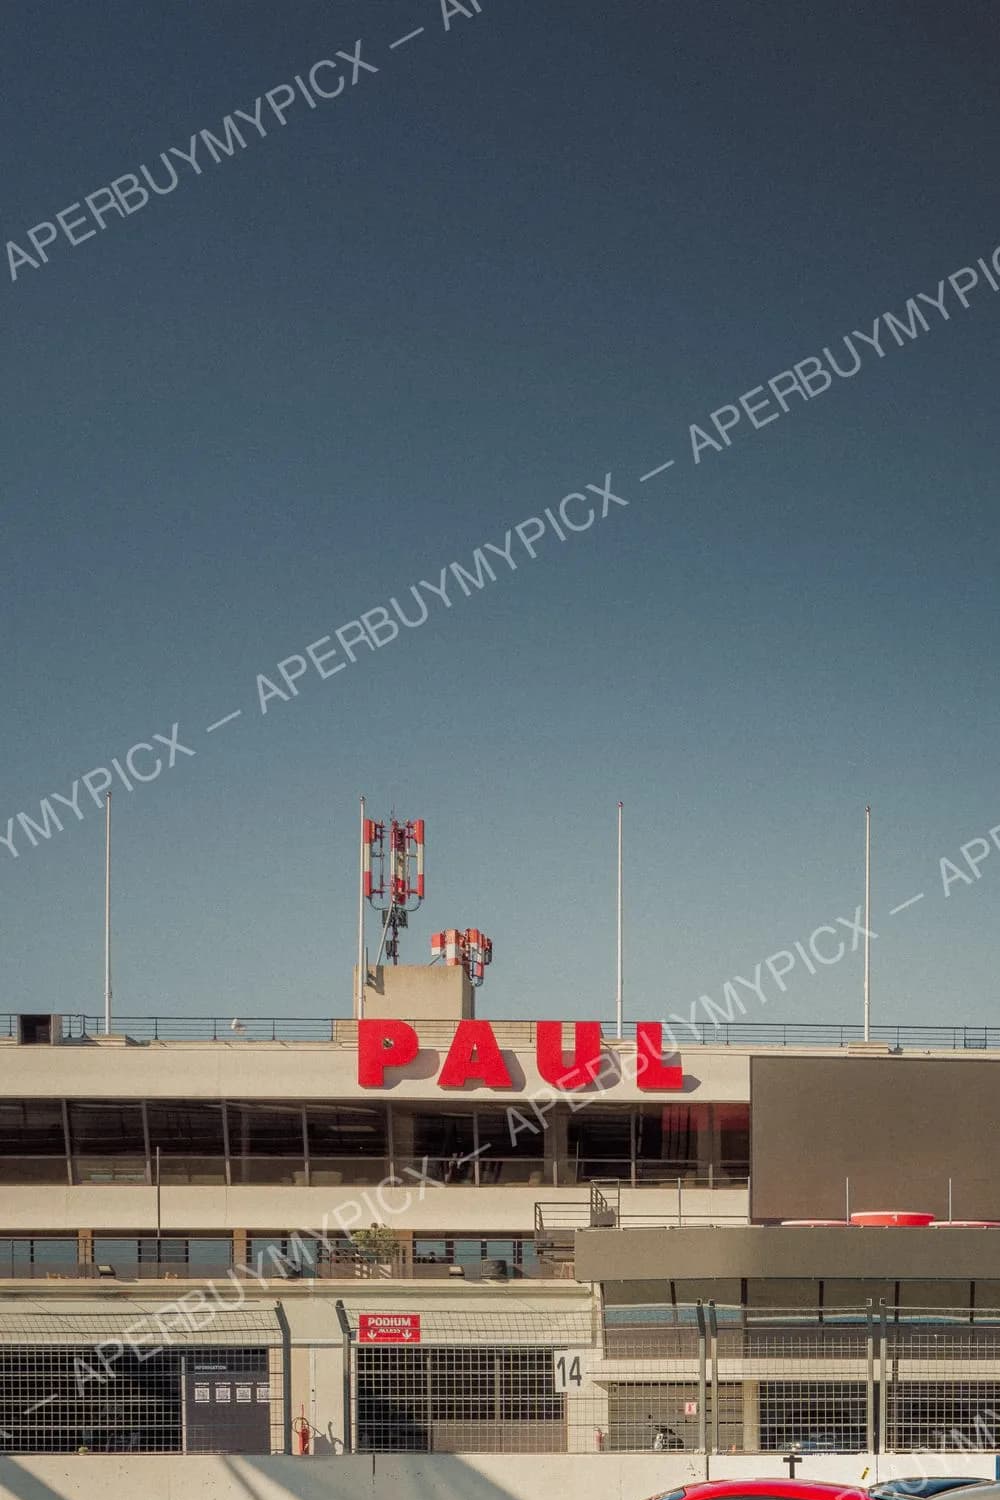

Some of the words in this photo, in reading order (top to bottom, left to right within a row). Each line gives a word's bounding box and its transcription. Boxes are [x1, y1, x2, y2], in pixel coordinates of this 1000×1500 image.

[357, 1019, 684, 1091] PAUL
[367, 1317, 411, 1327] PODIUM
[556, 1356, 582, 1387] 14
